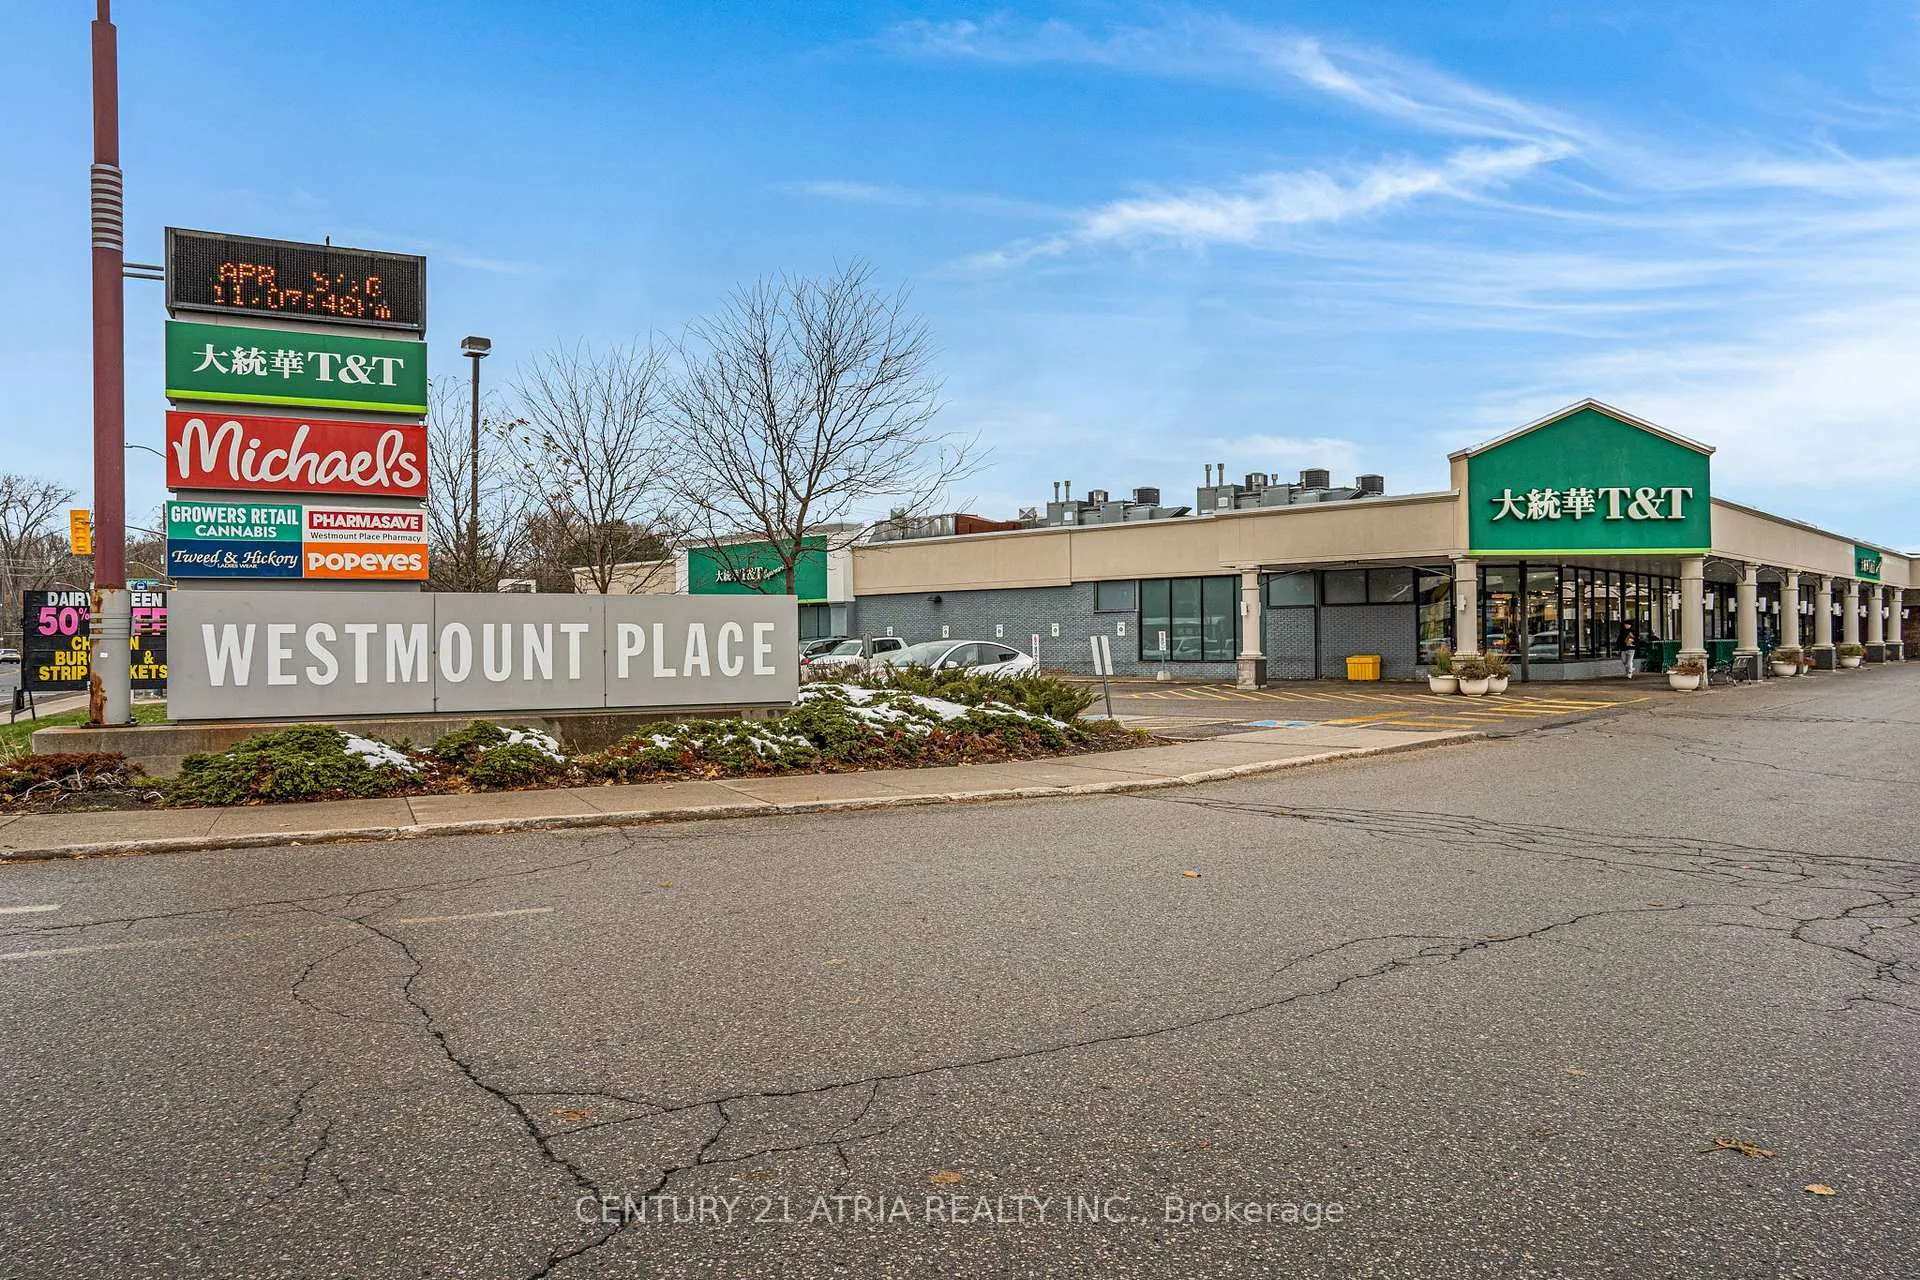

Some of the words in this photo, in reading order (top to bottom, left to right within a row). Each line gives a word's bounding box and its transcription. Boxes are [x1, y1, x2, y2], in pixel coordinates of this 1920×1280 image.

[193, 344, 304, 379] 大統華
[308, 351, 404, 386] T&T
[172, 418, 421, 488] Michaels
[1492, 488, 1595, 521] 大統華
[1599, 487, 1693, 520] T&T
[171, 505, 246, 524] GROWERS
[251, 508, 299, 525] RETAIL
[313, 513, 419, 529] PHARMASAVE
[195, 525, 277, 538] CANNABIS
[311, 532, 357, 540] Westmount
[360, 533, 381, 541] Place
[383, 534, 422, 543] Pharmacy
[171, 549, 222, 564] Tweed
[224, 551, 238, 564] &
[242, 550, 298, 569] Hickory
[201, 622, 589, 687] WESTMOUNT
[616, 621, 776, 679] PLACE
[39, 666, 85, 681] STRIP
